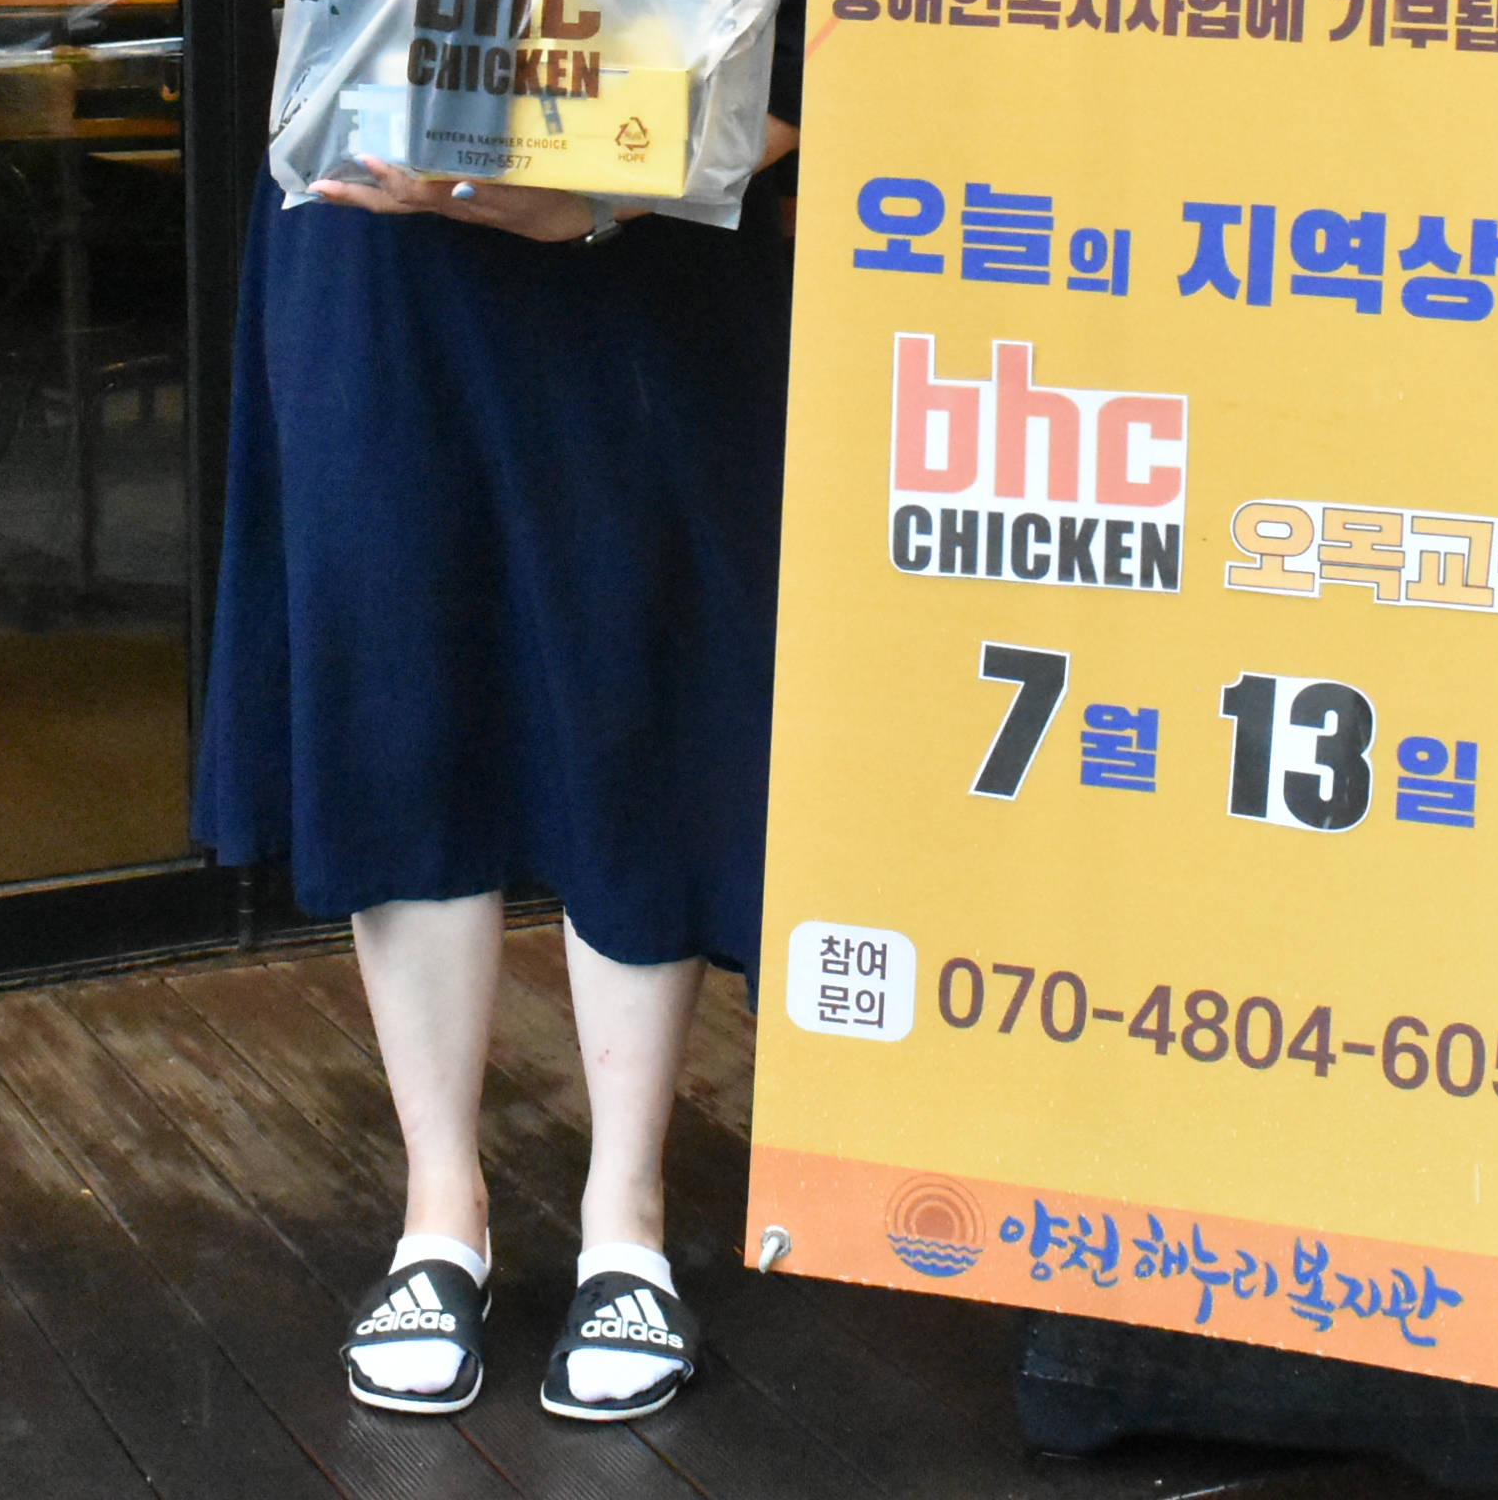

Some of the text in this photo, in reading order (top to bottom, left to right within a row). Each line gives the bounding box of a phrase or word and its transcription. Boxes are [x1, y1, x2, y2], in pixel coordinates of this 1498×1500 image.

[407, 38, 601, 99] CHICKEN
[456, 150, 533, 169] 1577-5577
[526, 138, 568, 150] CHOICE
[617, 153, 646, 163] HDPE
[852, 175, 1131, 297] 오늘의
[892, 333, 1185, 508] bhc
[892, 504, 1182, 591] CHICKEN
[818, 934, 888, 982] 참여
[816, 984, 887, 1030] 문의
[356, 1307, 456, 1336] adidas
[581, 1317, 684, 1349] adidas
